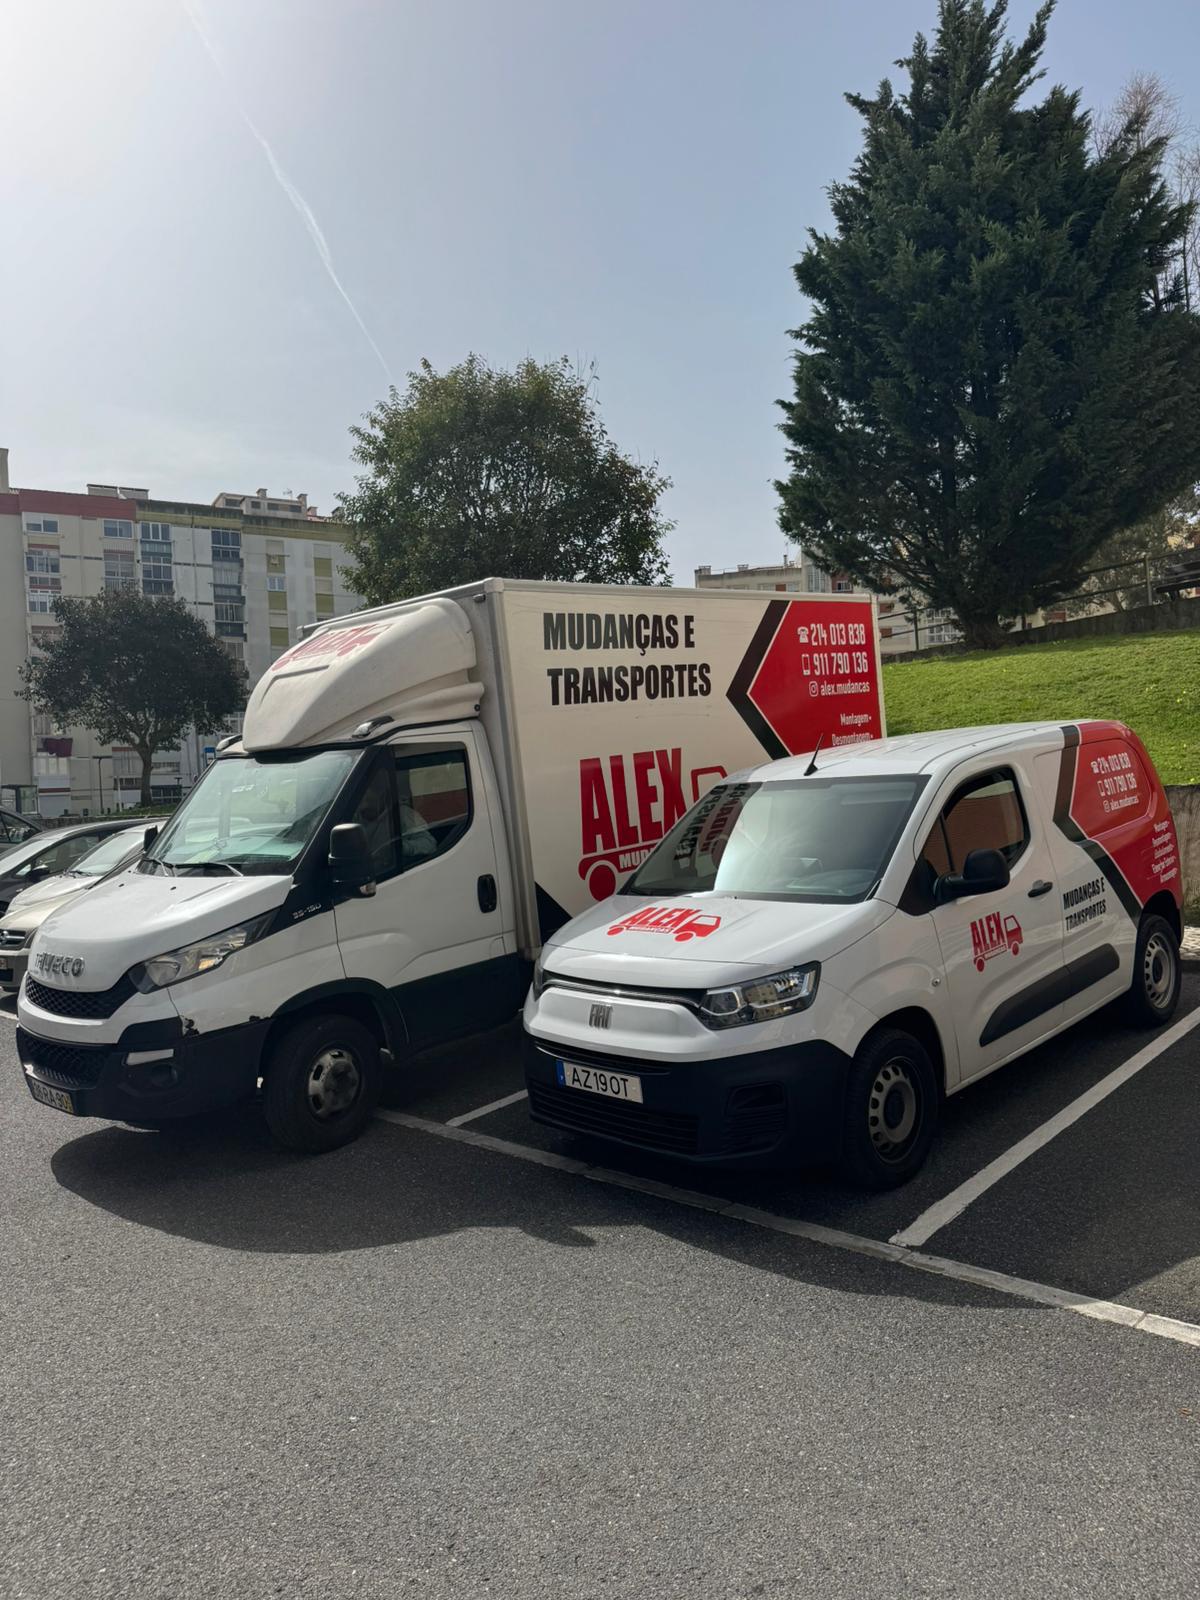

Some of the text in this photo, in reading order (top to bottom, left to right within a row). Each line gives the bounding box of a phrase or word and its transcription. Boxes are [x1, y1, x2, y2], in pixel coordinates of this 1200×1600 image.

[543, 612, 695, 656] MUDANÇAS E
[810, 623, 866, 646] 214 013 838
[813, 651, 868, 676] 911 790 136
[547, 663, 711, 706] TRANSPORTES
[820, 679, 870, 696] alex.mudancas
[579, 748, 688, 855] ALEX
[618, 907, 703, 930] ALEX
[1065, 899, 1106, 931] TRANSPORTES
[970, 911, 1006, 956] ALEX
[589, 1003, 613, 1029] FIAT
